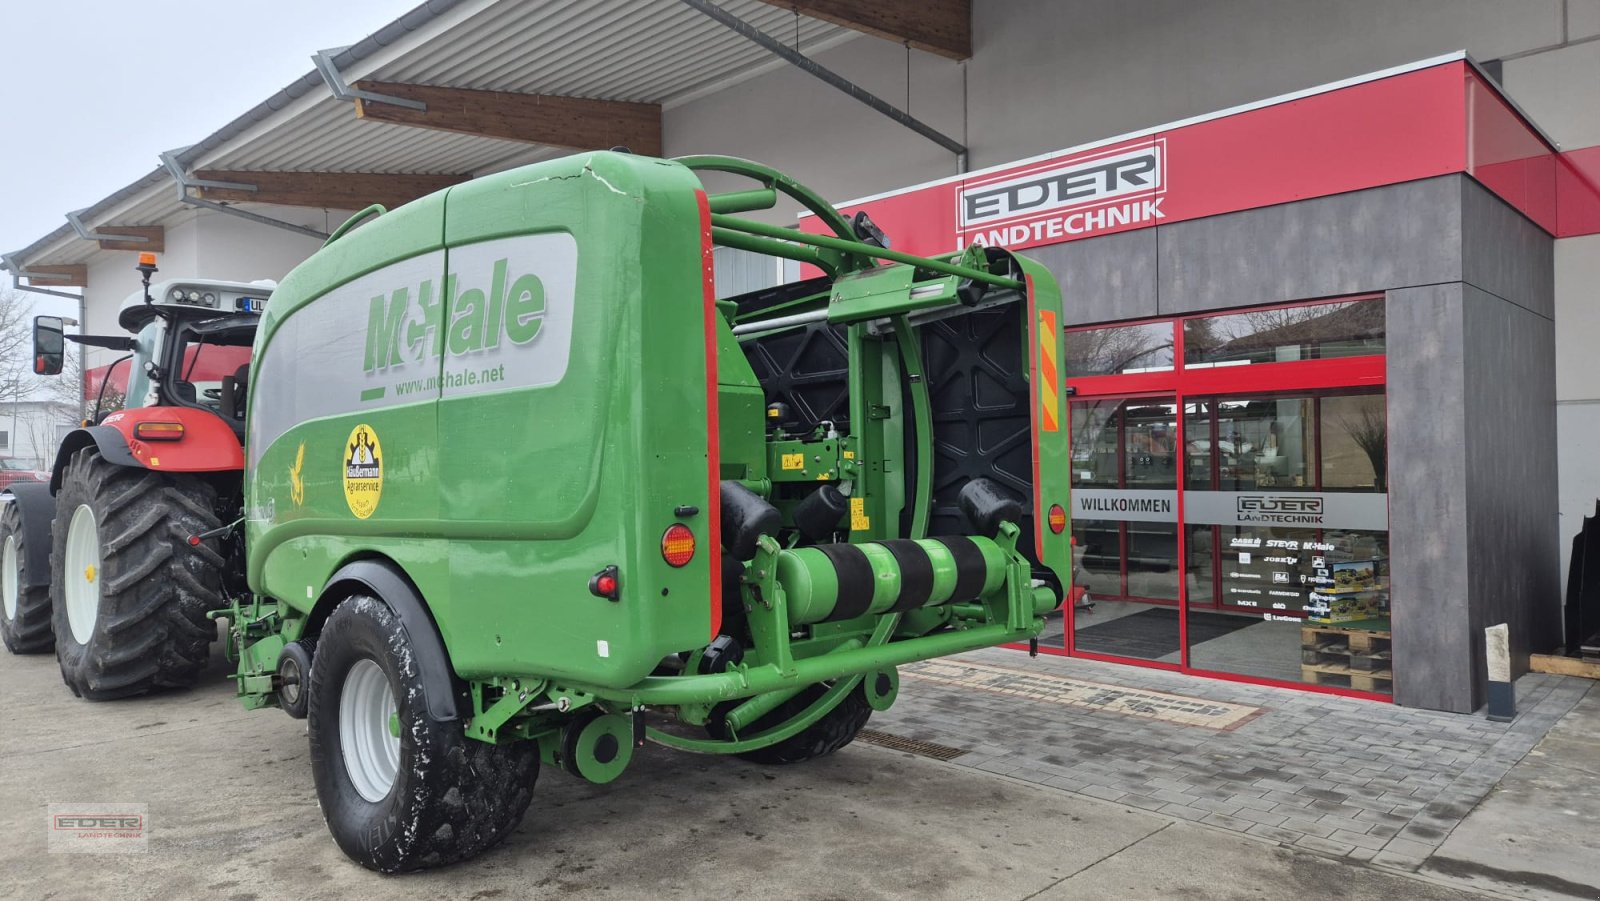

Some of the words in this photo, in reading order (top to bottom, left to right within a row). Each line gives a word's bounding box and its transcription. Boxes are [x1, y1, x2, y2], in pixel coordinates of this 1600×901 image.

[964, 154, 1156, 221] EDER
[957, 197, 1166, 251] LANDTECHNIK
[363, 257, 545, 372] McHale
[396, 364, 504, 396] www.mchale.net
[347, 480, 379, 494] Agrarservice
[1081, 498, 1171, 513] WILLKOMMEN
[1241, 499, 1320, 512] EDER
[1237, 514, 1323, 524] LANDTECHNIK
[1266, 540, 1298, 550] STEYR
